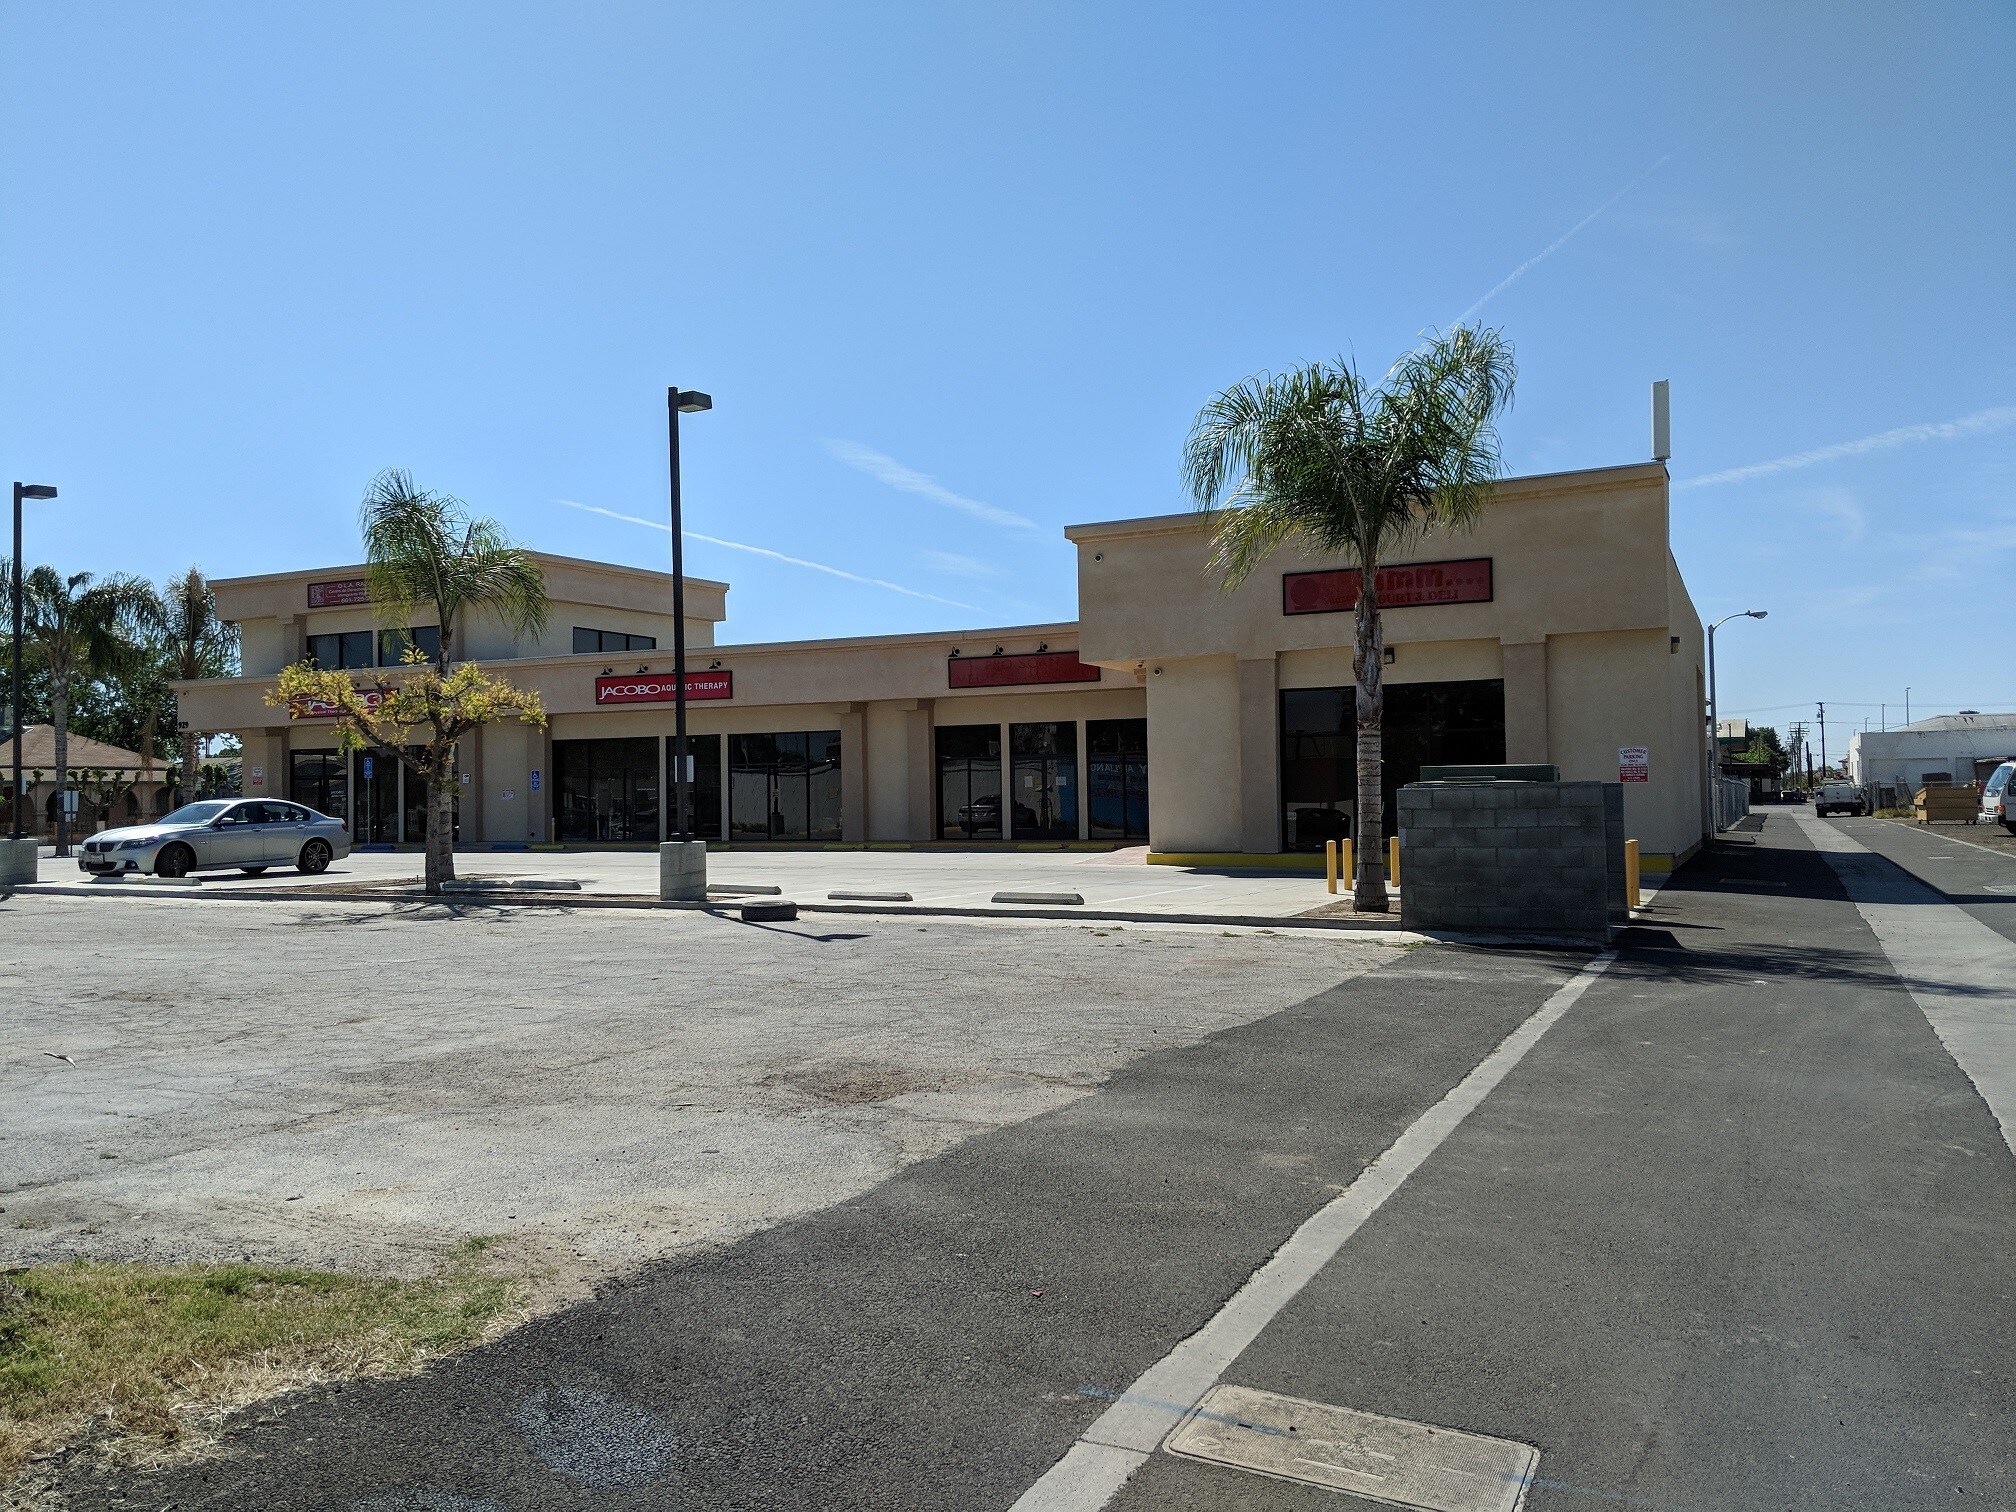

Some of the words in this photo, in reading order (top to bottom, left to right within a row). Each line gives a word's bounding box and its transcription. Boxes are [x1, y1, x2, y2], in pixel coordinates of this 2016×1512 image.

[1428, 588, 1460, 602] DELI
[599, 685, 660, 699] JACOBO
[661, 684, 693, 692] AQUIC
[694, 681, 728, 690] THERAPY
